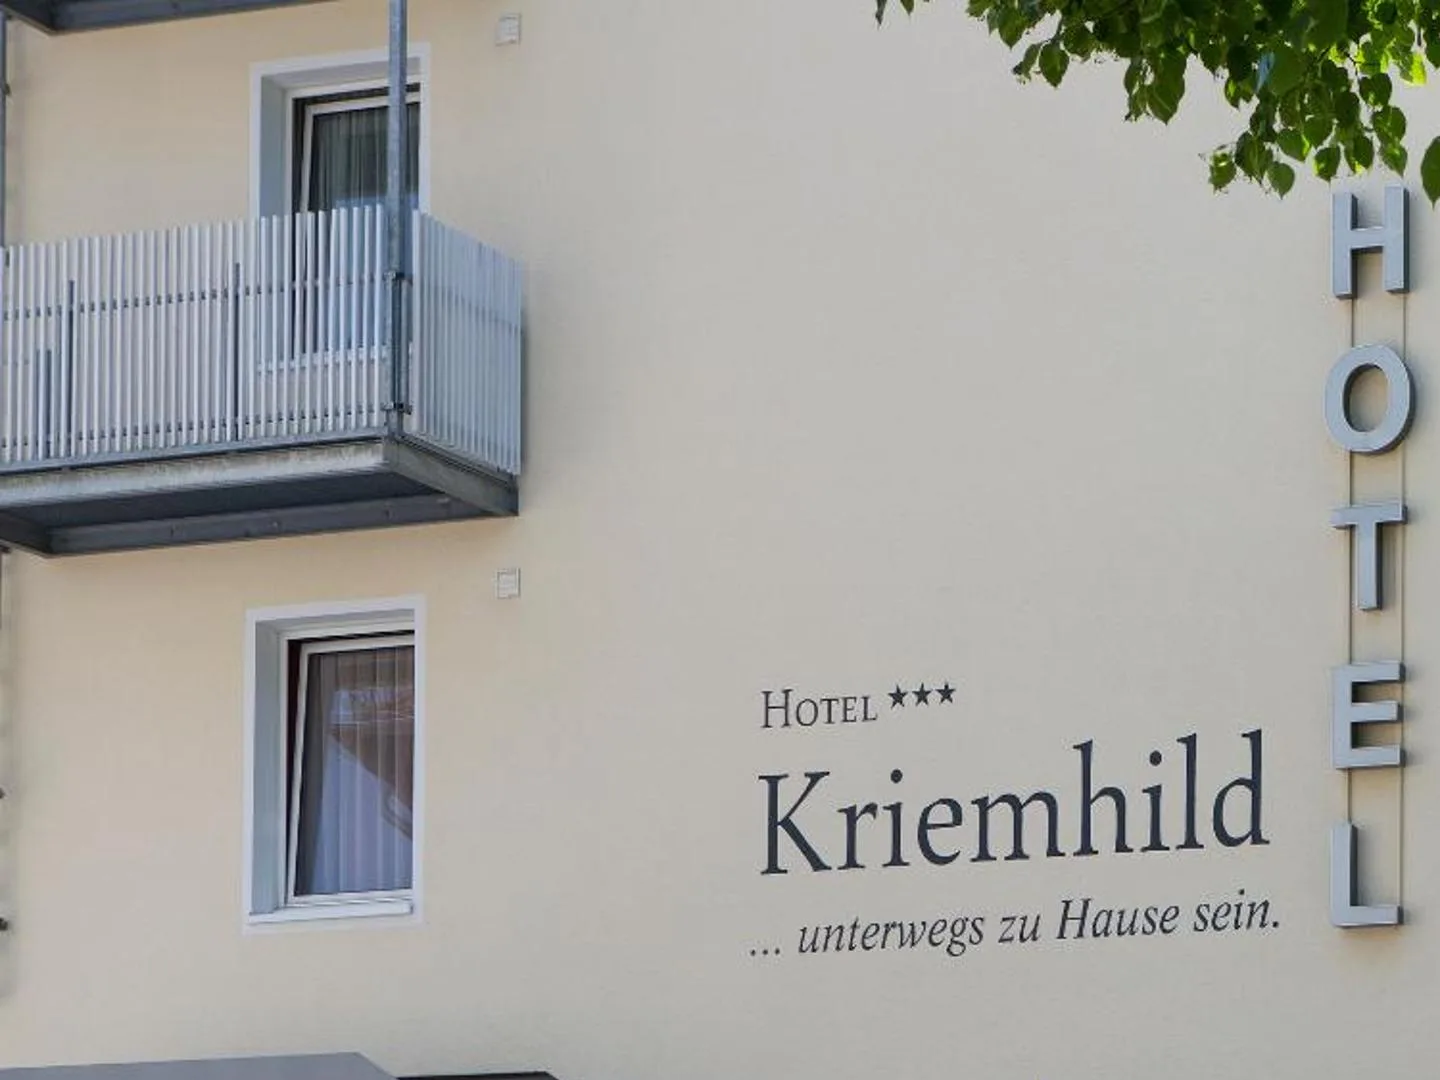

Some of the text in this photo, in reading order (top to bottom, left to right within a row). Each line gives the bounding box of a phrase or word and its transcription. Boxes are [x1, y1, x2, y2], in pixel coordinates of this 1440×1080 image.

[1324, 186, 1415, 929] HOTEL
[758, 728, 1271, 876] Kriemhild
[798, 914, 985, 957] unterwegs
[997, 915, 1042, 945] zu
[1055, 897, 1180, 940] Hause
[1192, 888, 1281, 932] sein.
